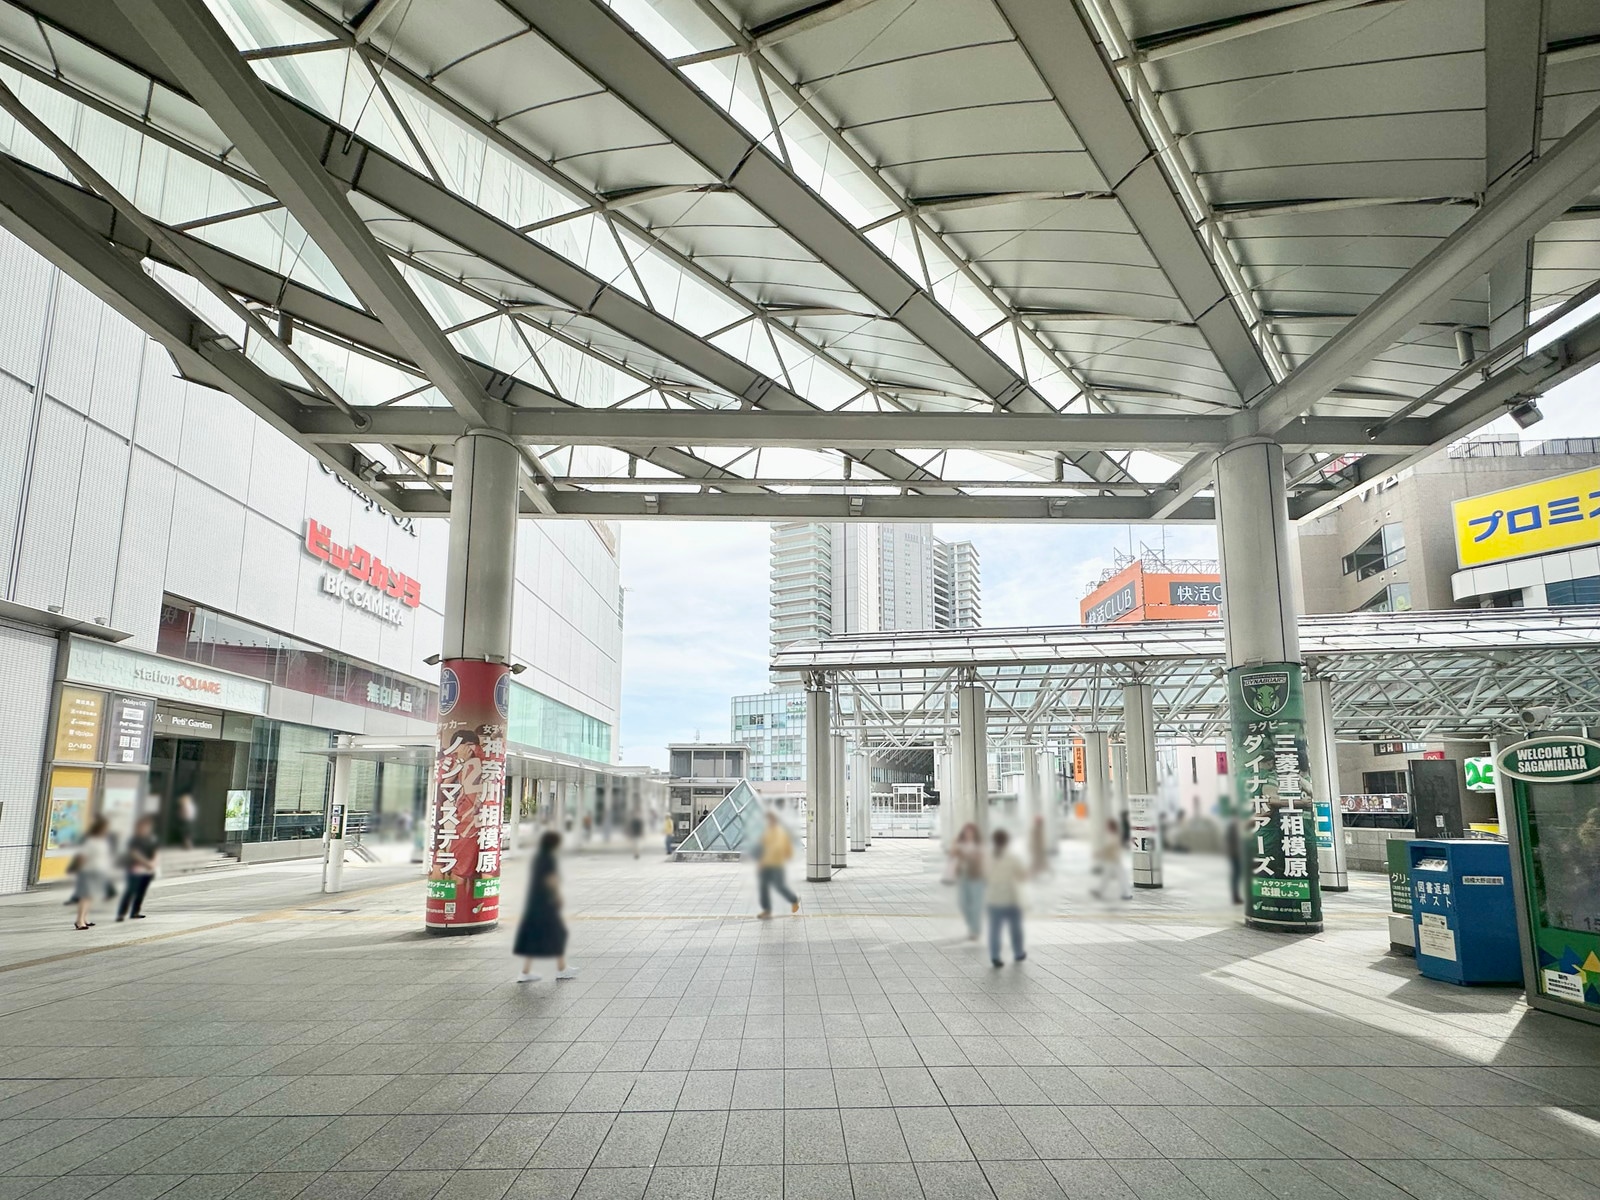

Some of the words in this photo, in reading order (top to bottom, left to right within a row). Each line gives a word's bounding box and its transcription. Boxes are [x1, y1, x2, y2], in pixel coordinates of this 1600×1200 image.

[305, 517, 421, 609] ビックカメラ
[134, 667, 175, 687] station
[177, 674, 222, 695] SQUARE
[366, 680, 413, 713] 無印良品
[188, 718, 213, 730] Garden
[1248, 719, 1288, 732] ラグビー
[1516, 746, 1568, 761] WELCOME
[1570, 744, 1586, 757] TO
[1517, 757, 1588, 773] SAGAMIHARA
[435, 736, 465, 874] ノジマステラ
[475, 736, 503, 874] 神奈川相模原
[1242, 733, 1276, 877] ダイナボアーズ
[1273, 733, 1309, 878] 三菱重工相模原
[1260, 886, 1301, 898] 応援しよう
[1416, 881, 1451, 896] 図書返却
[1419, 893, 1452, 908] ポスト
